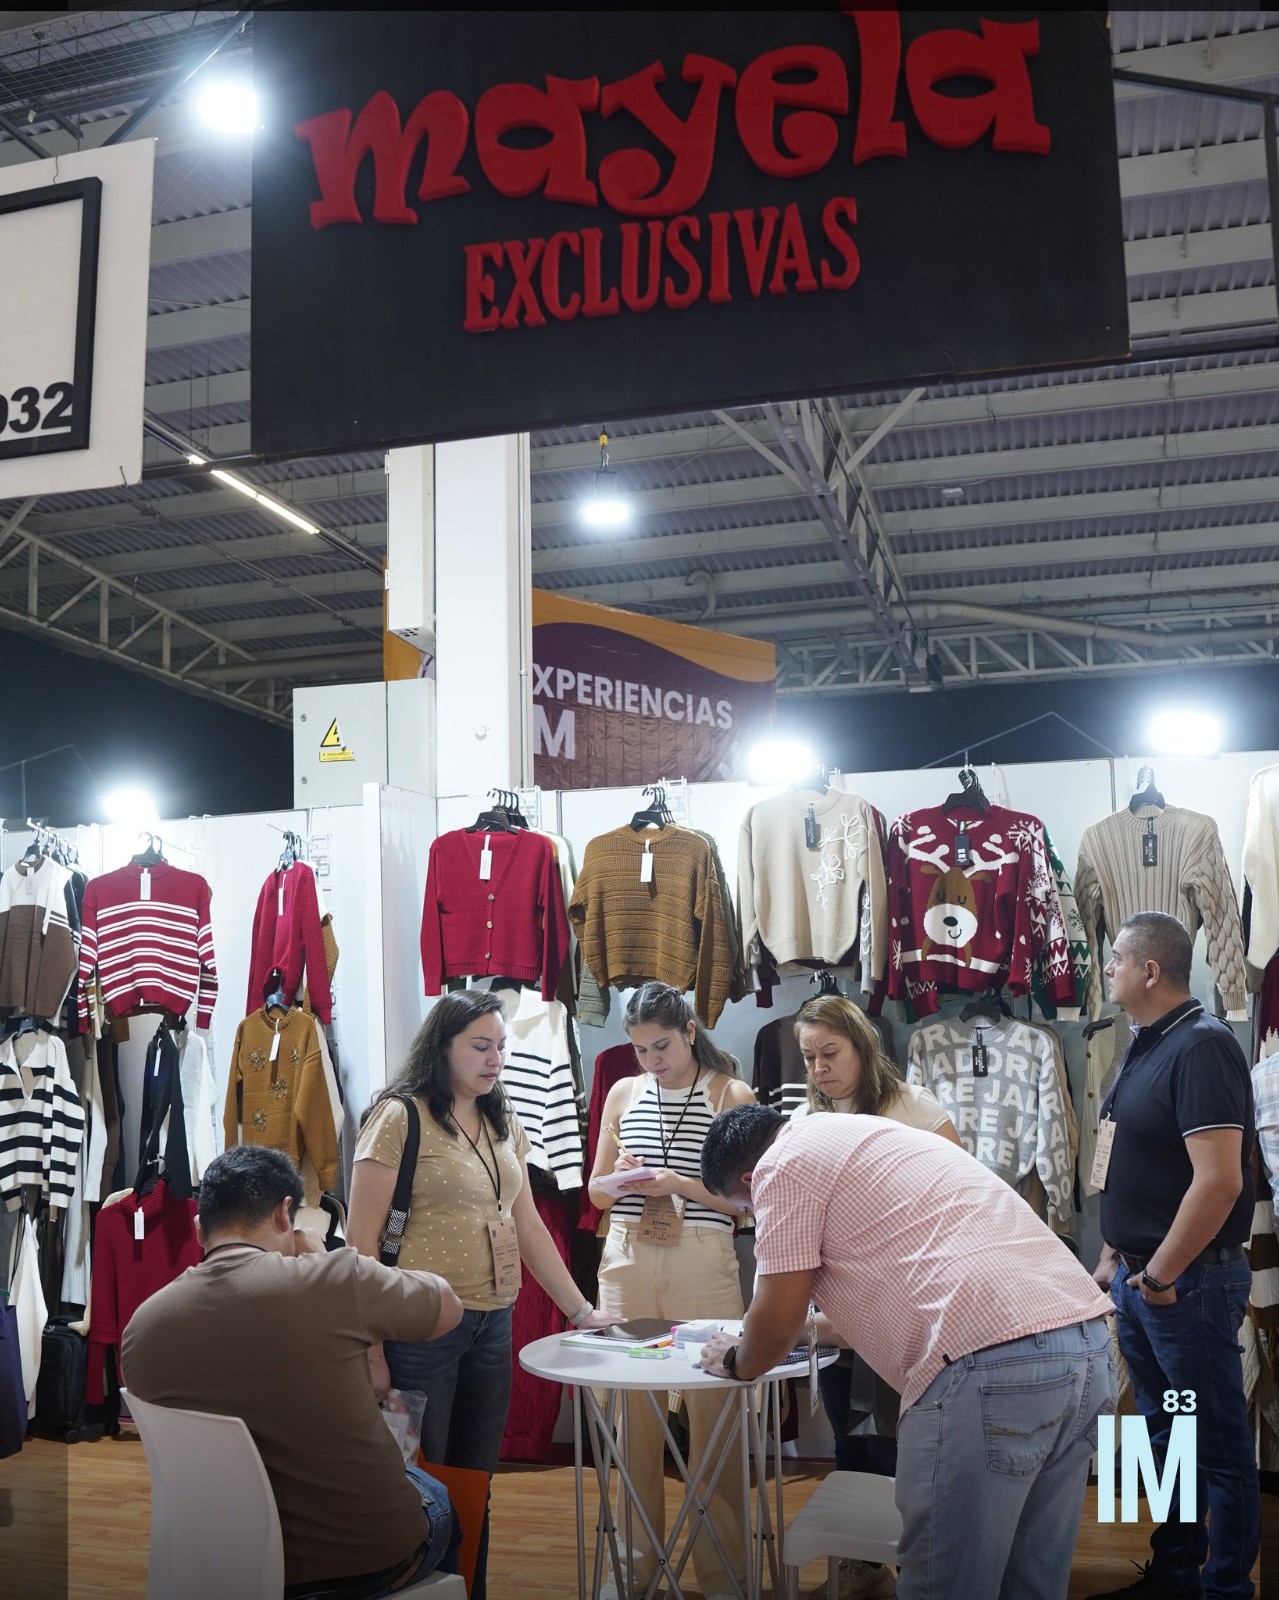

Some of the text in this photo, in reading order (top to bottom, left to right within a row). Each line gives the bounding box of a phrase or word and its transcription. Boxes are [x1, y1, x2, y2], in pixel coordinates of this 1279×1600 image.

[293, 0, 1051, 231] mayela
[463, 196, 862, 334] EXCLUSIVAS
[0, 381, 75, 434] 32
